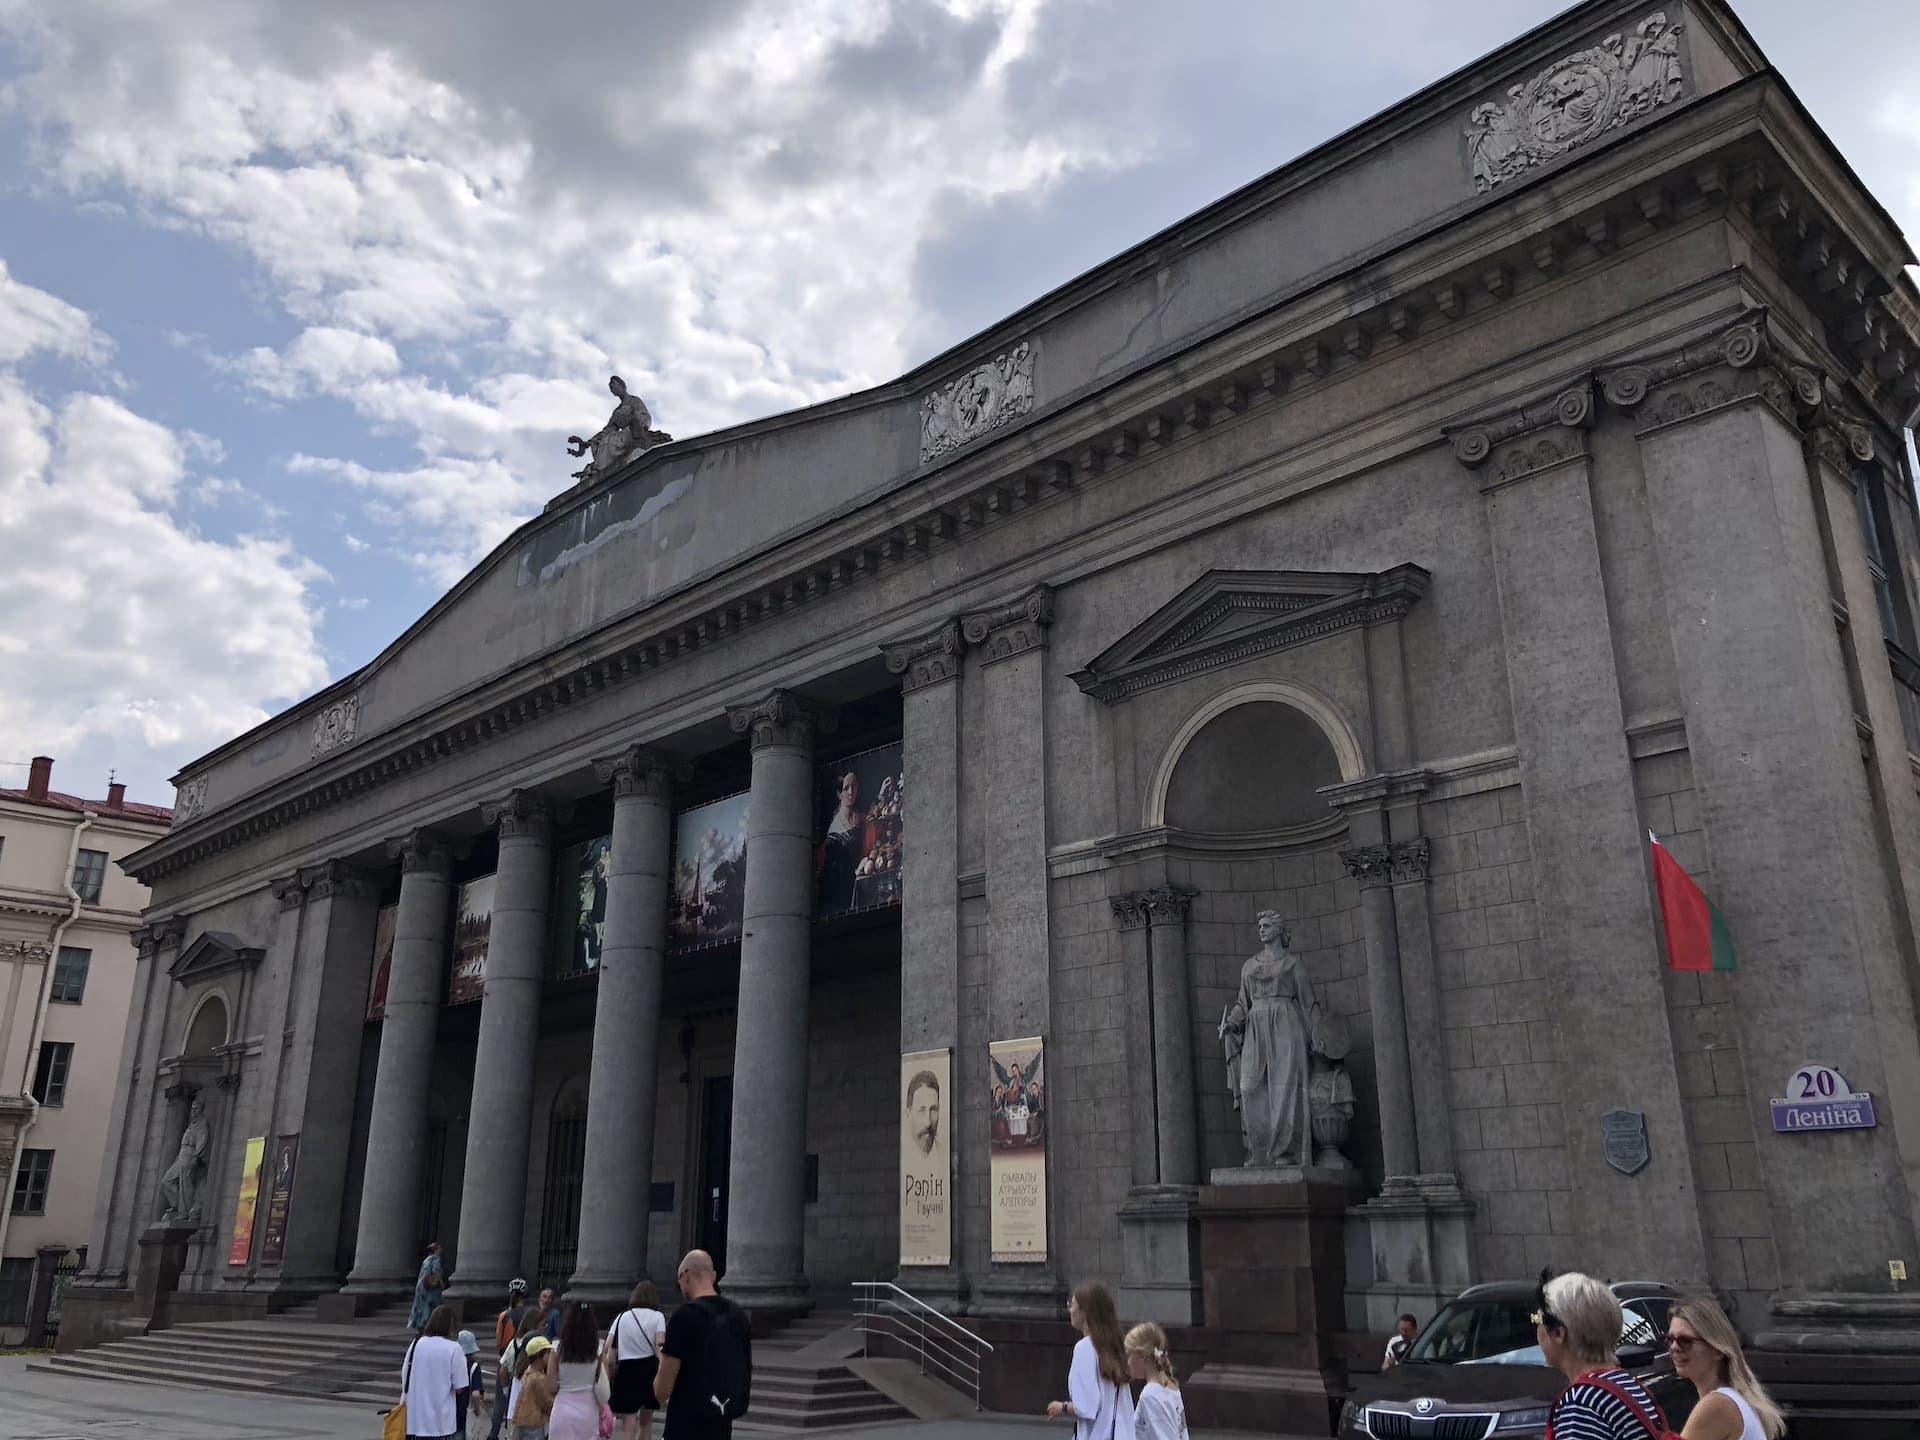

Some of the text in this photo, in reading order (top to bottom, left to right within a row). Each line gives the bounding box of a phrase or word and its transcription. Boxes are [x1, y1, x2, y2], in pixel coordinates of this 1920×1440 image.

[1796, 1070, 1835, 1098] 20
[1786, 1106, 1863, 1127] Леніна
[905, 1173, 943, 1206] Рэпін
[998, 1184, 1038, 1195] АТРЫБУТЫ
[922, 1200, 944, 1218] вучні
